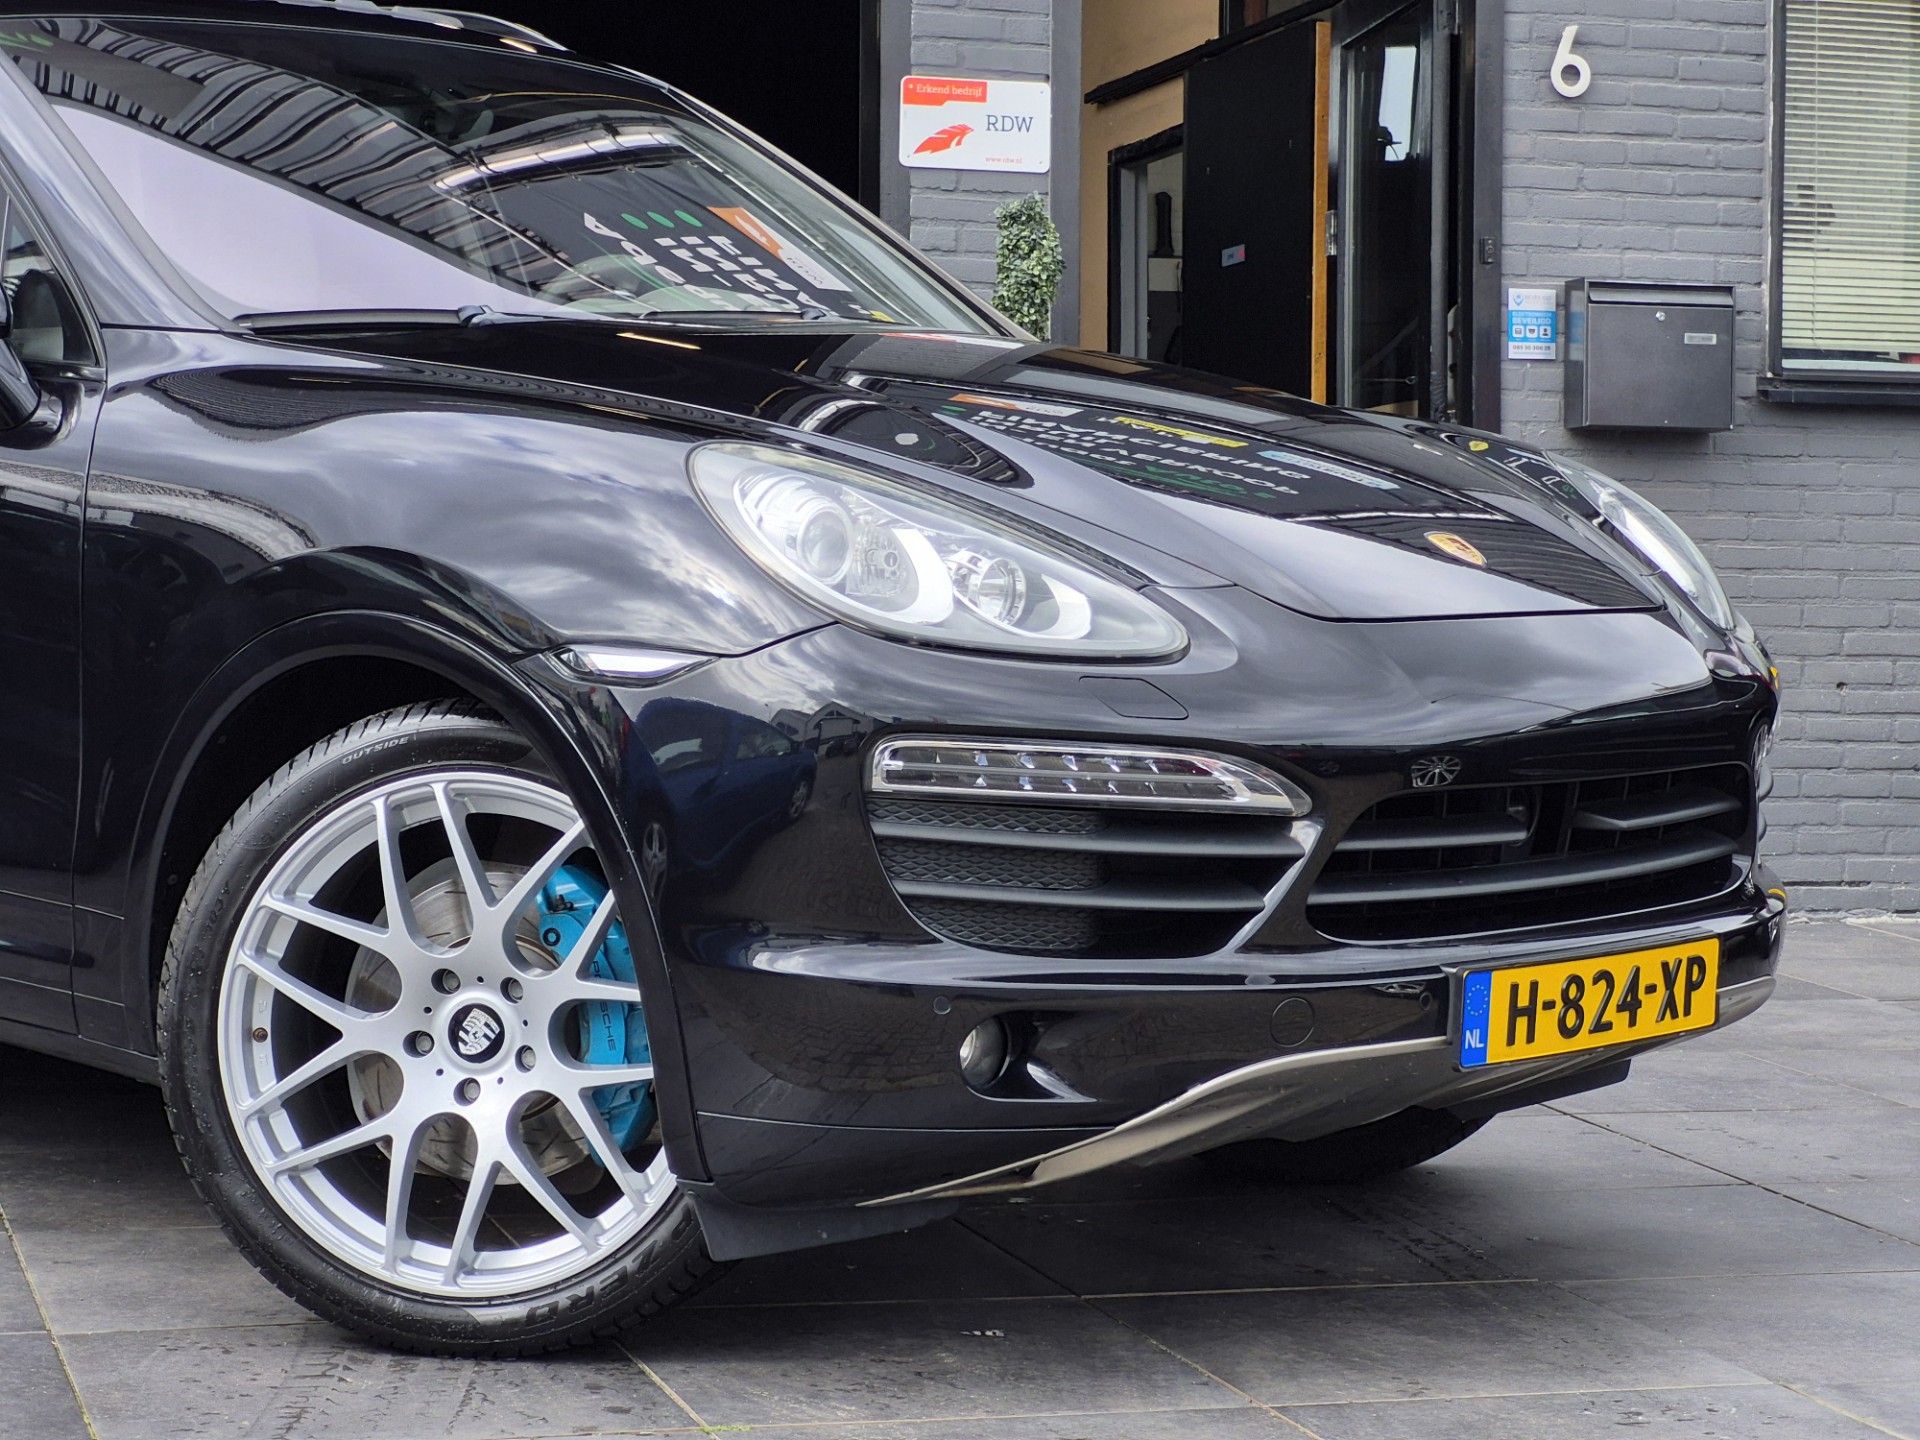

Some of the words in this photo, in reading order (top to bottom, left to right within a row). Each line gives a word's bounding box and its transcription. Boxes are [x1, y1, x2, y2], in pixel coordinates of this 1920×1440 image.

[1550, 25, 1591, 97] 6
[916, 84, 950, 94] Erkend
[952, 86, 983, 97] bedrijf
[985, 114, 1034, 133] RDW
[341, 736, 410, 765] OUTSIDE
[593, 960, 617, 1052] PSCHE
[1506, 954, 1707, 1047] H-824-XP
[1464, 1029, 1485, 1049] NL
[525, 1239, 660, 1328] ZERO
